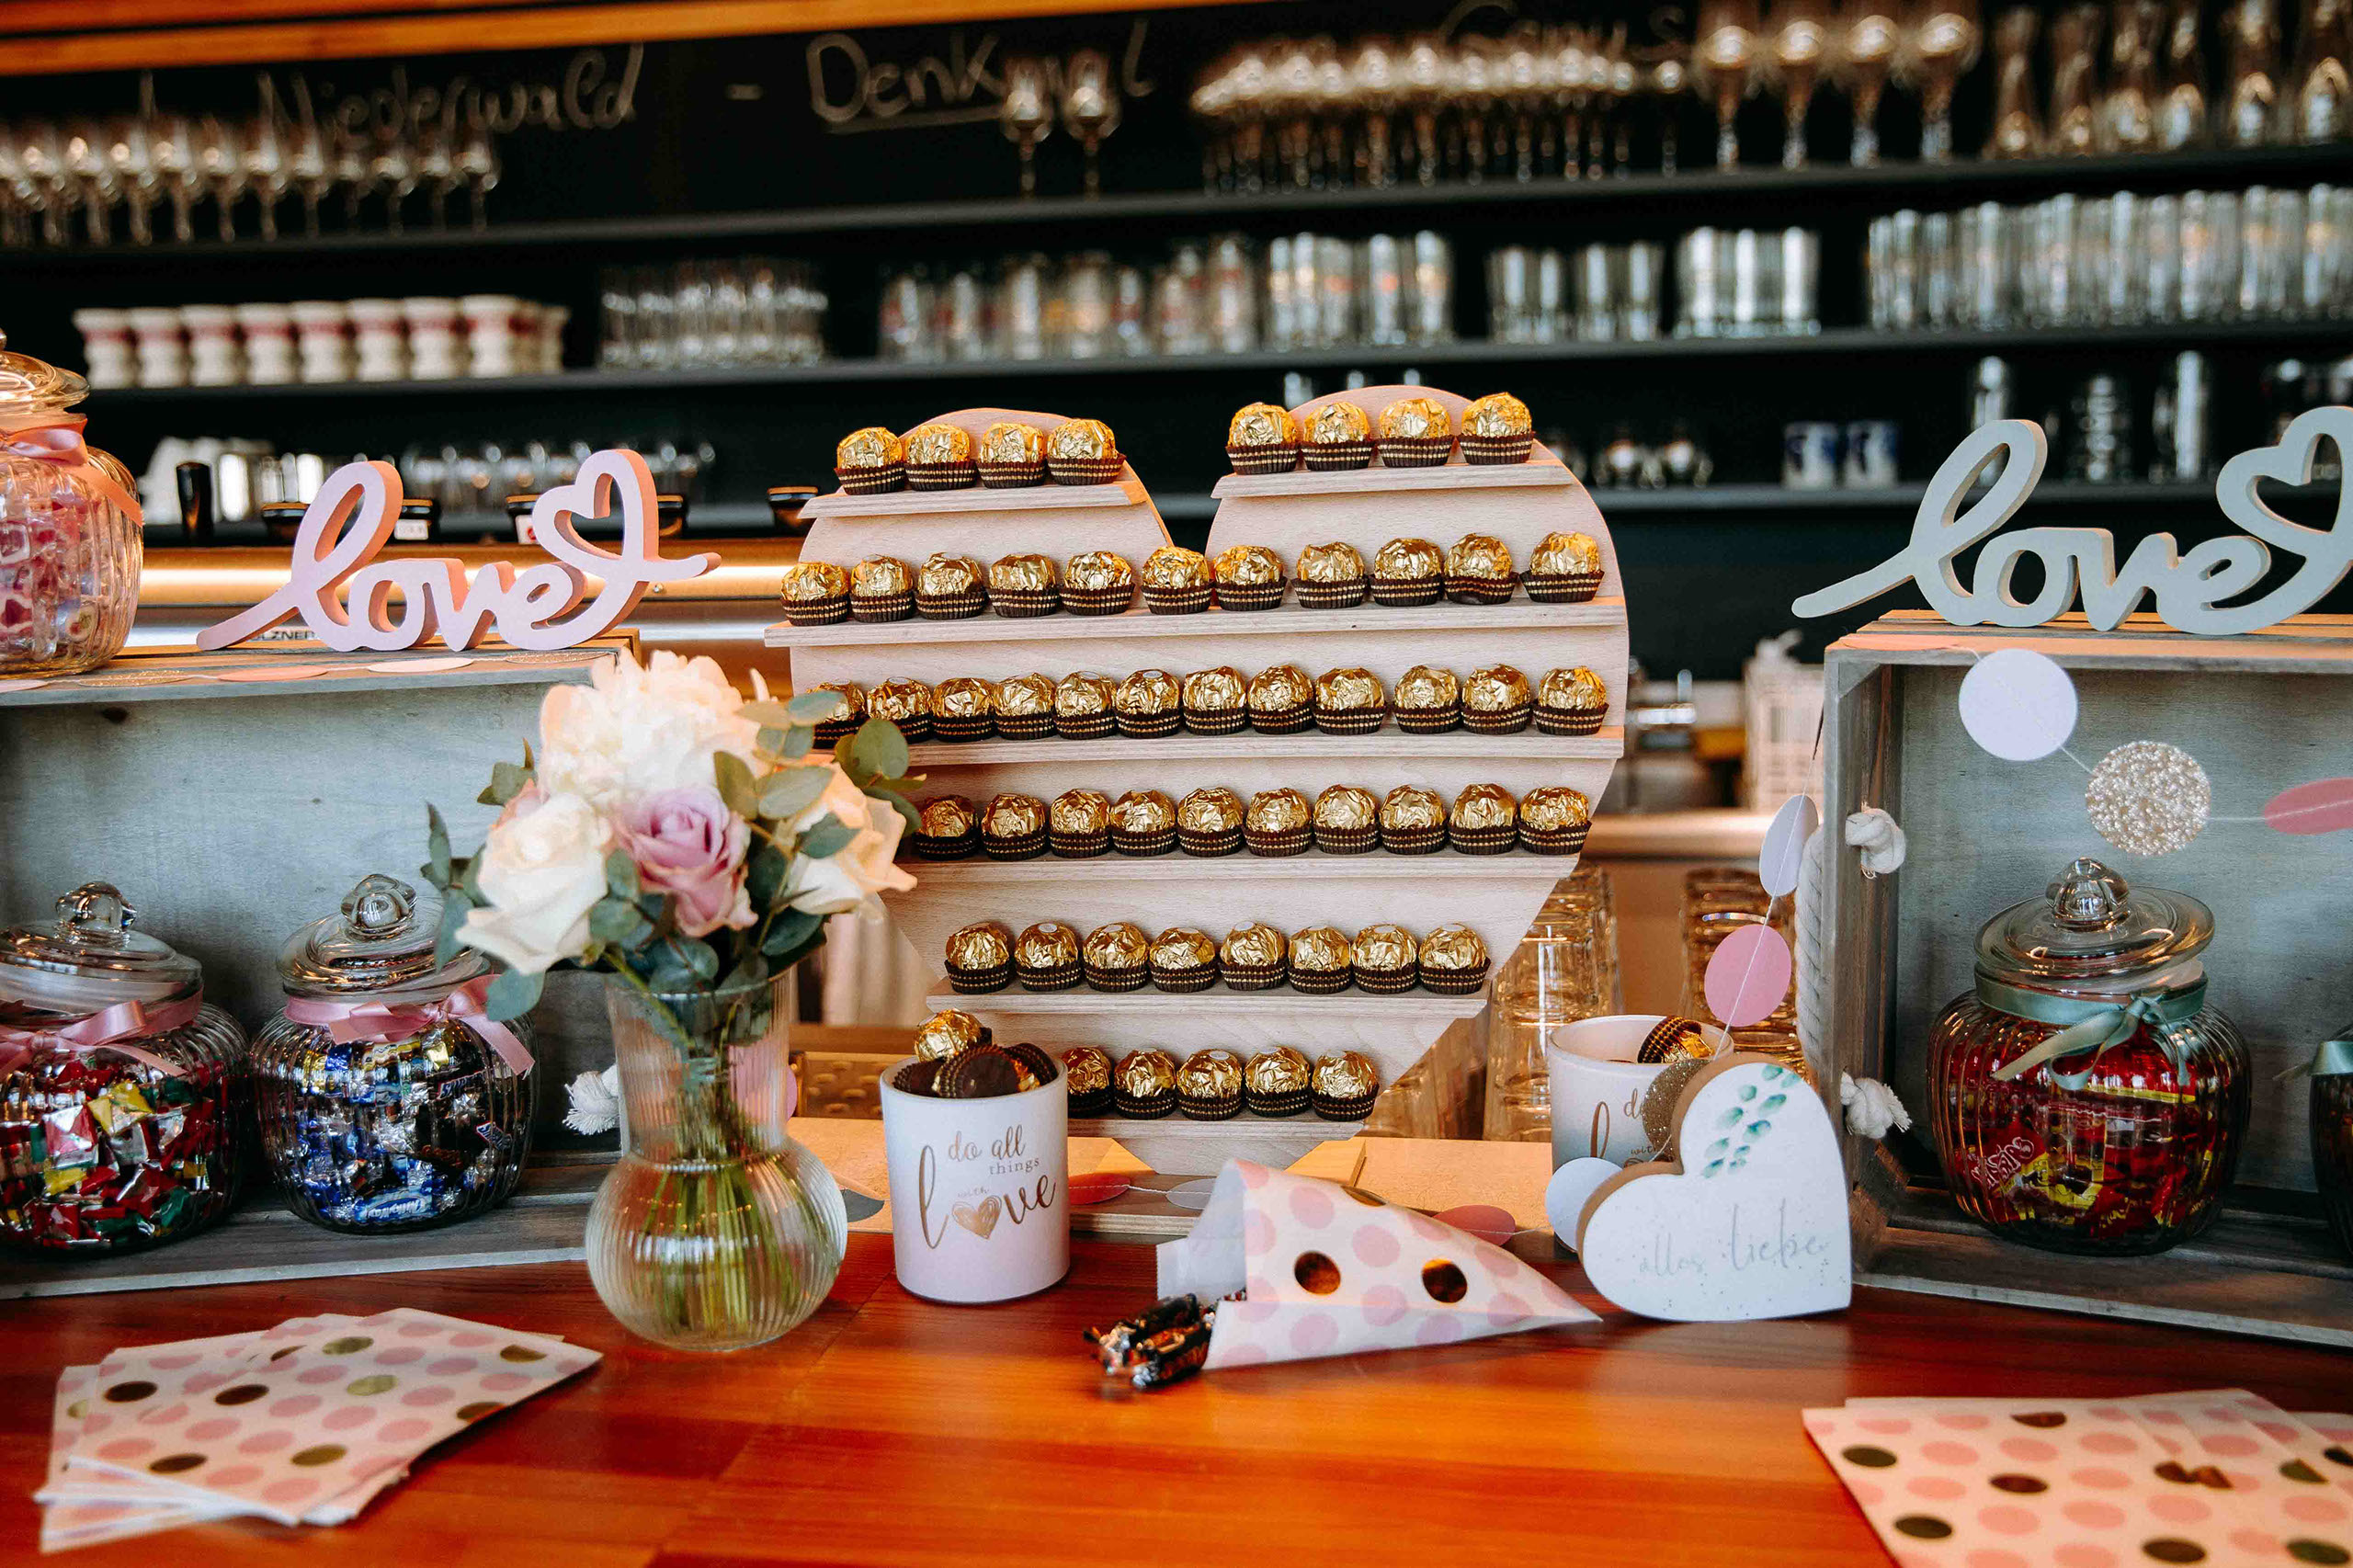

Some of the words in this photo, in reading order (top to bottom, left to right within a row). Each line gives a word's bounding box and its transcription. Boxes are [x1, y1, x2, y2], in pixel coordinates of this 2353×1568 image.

[1791, 405, 2353, 635] love
[196, 449, 722, 652] love
[949, 1131, 983, 1162] do
[991, 1124, 1026, 1160] all
[1630, 1145, 1654, 1154] wit
[989, 1158, 1040, 1175] things
